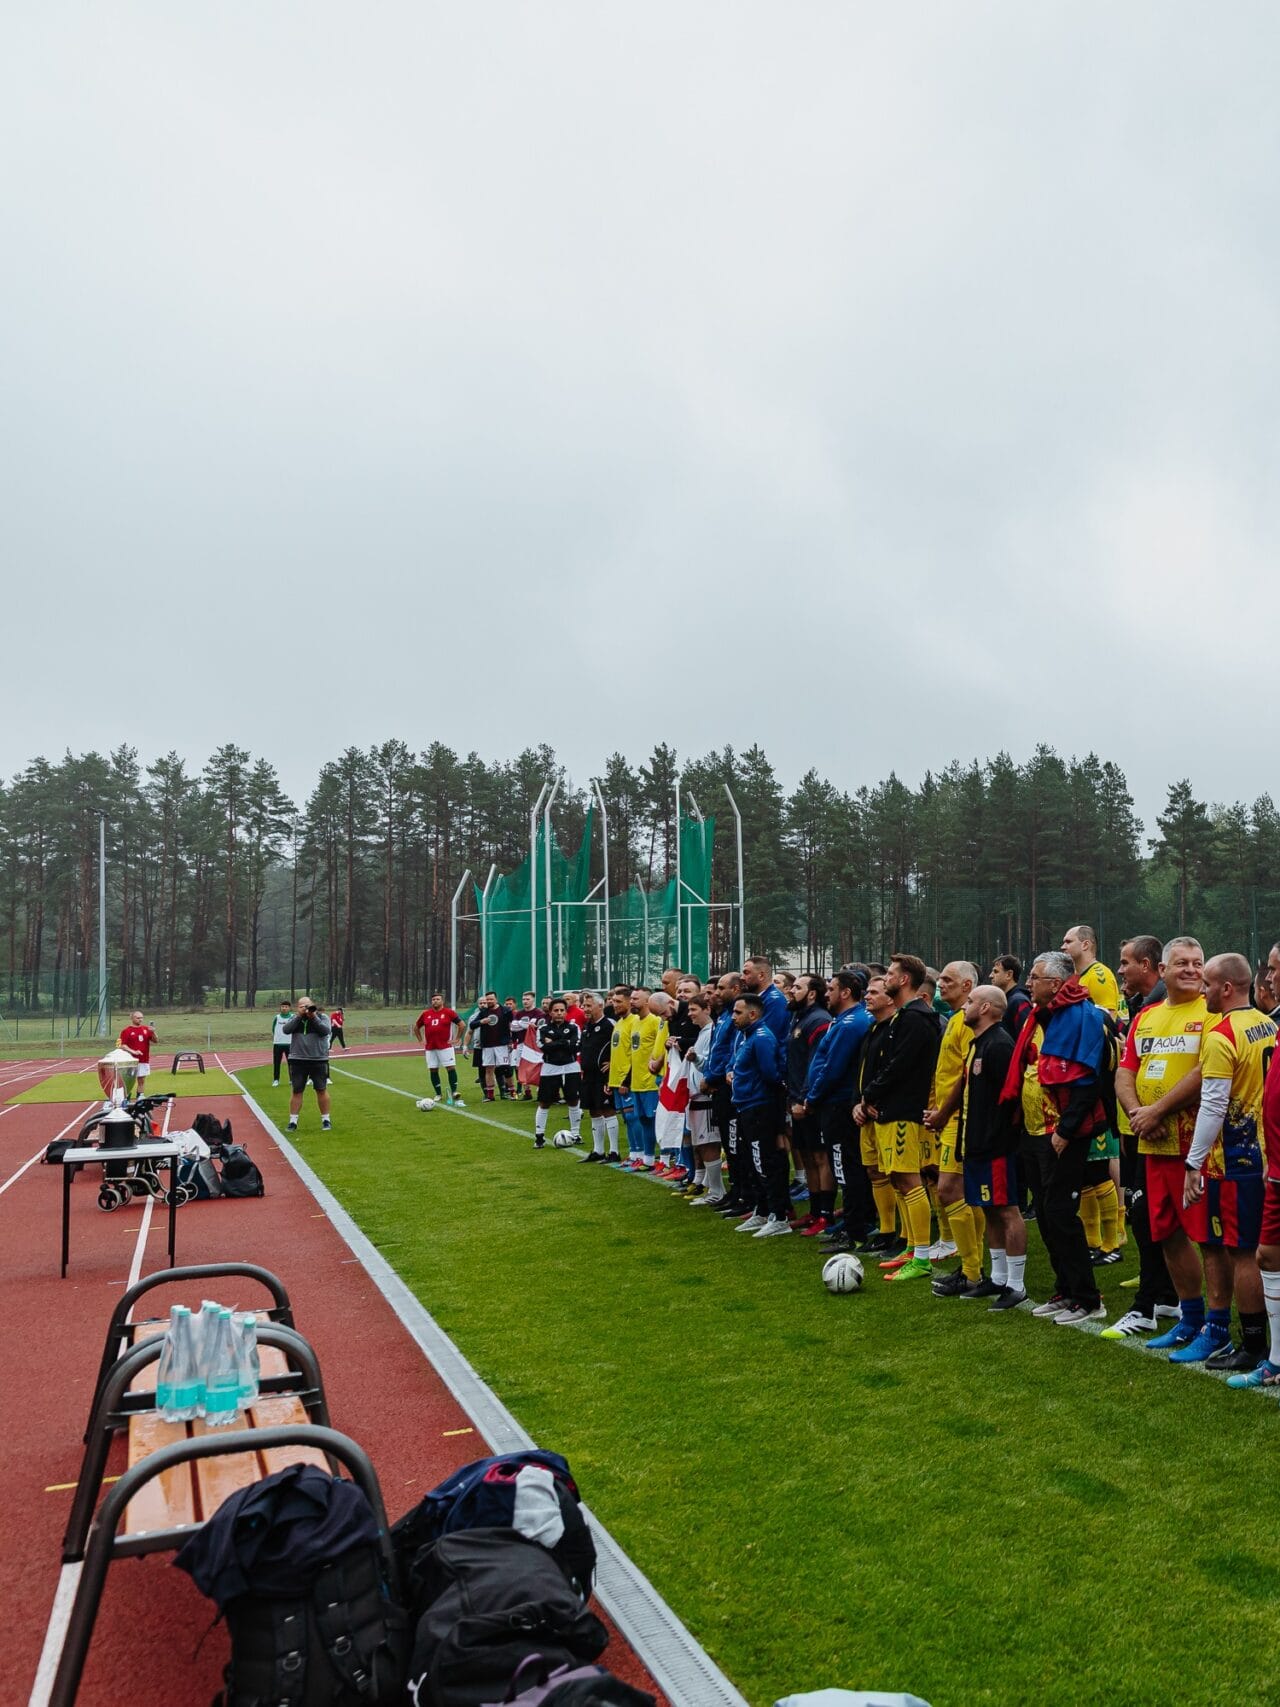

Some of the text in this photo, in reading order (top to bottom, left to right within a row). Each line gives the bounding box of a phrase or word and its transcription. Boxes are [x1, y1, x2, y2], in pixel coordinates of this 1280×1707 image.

[1153, 1036, 1186, 1049] AQUA
[1244, 1020, 1277, 1044] ROMÂN
[728, 1118, 738, 1155] LEGEA
[832, 1143, 847, 1185] LEGEA
[942, 1145, 951, 1166] 4
[980, 1184, 991, 1202] 5
[1211, 1215, 1223, 1237] 6
